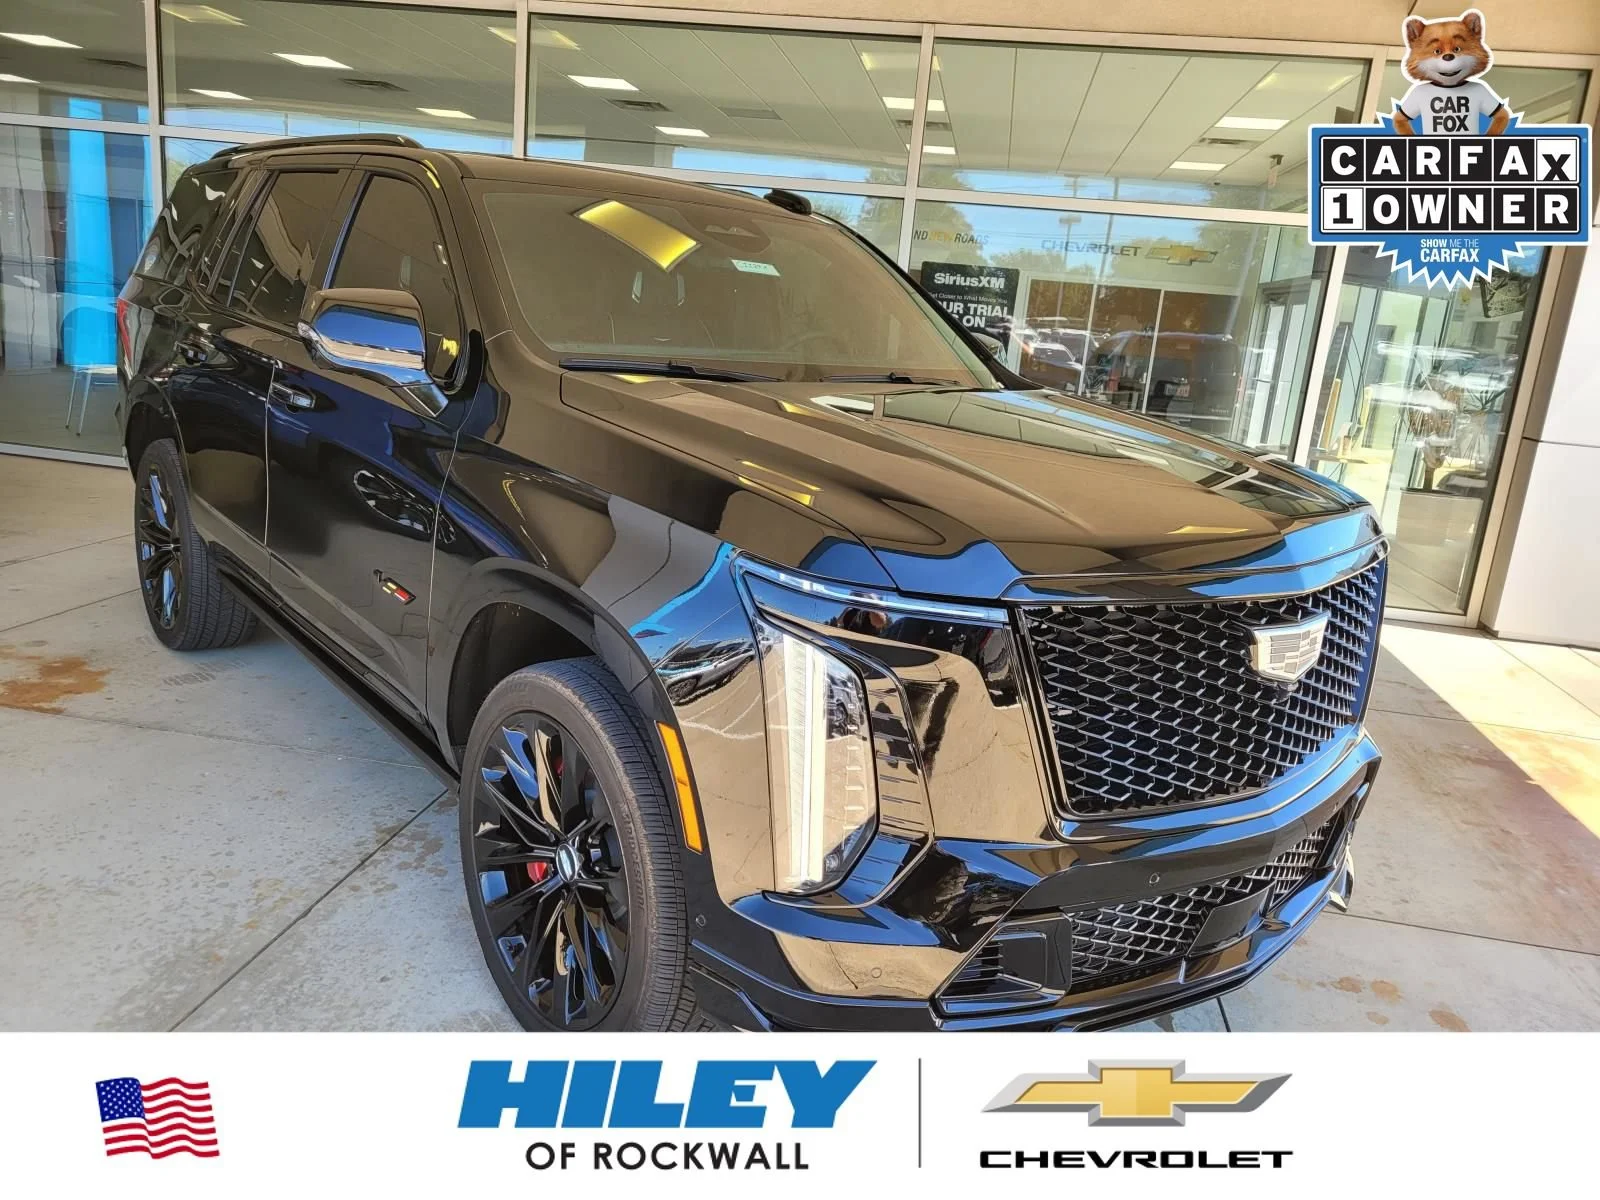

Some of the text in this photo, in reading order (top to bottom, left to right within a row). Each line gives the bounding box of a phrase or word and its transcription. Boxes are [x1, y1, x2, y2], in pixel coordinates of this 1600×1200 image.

[954, 232, 990, 245] ROADS
[1041, 239, 1142, 257] CHEVROLET
[933, 271, 1006, 289] SiriusXM
[937, 301, 1010, 319] UR TRIAL
[962, 315, 986, 329] ON
